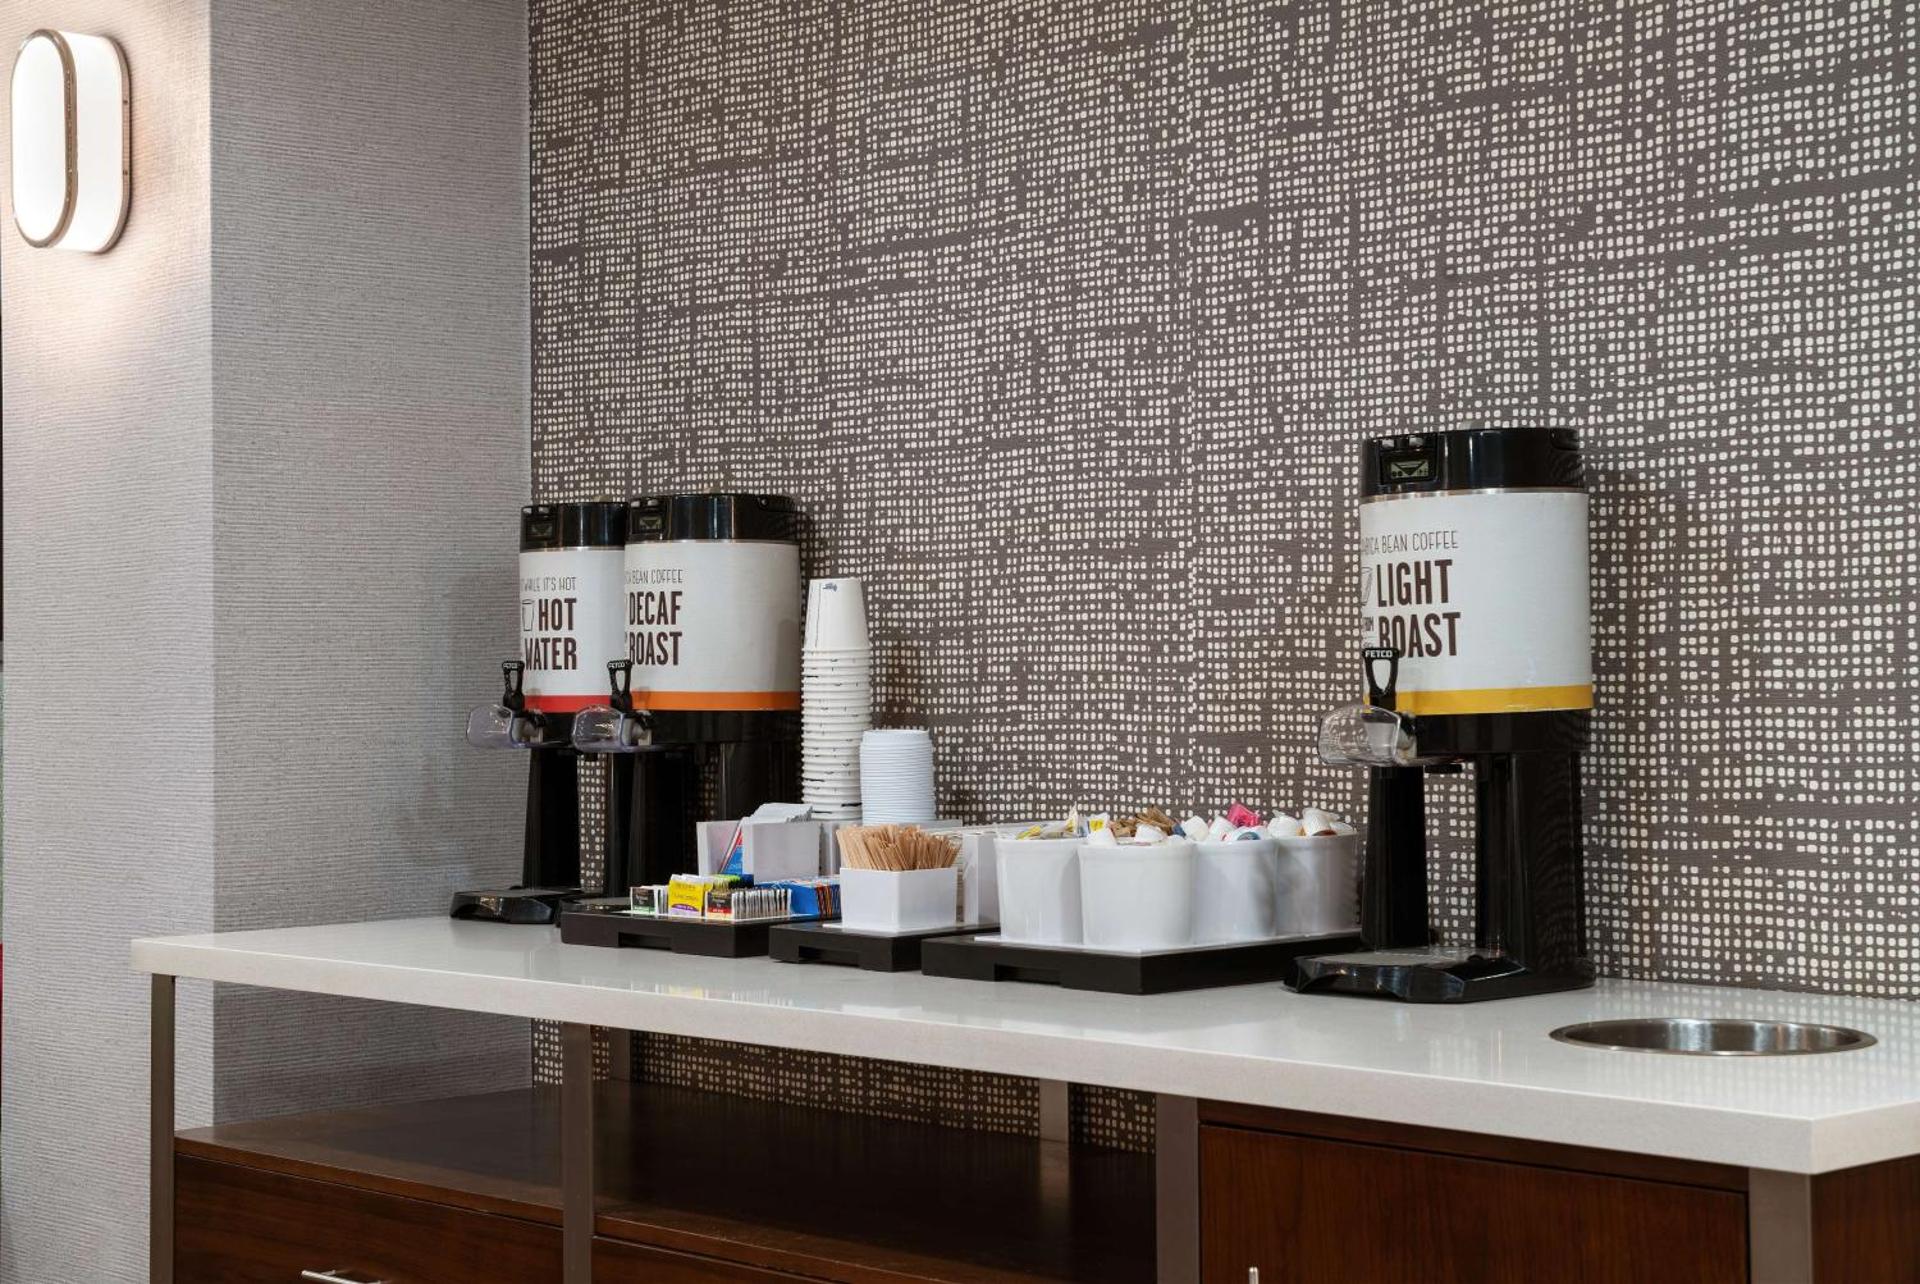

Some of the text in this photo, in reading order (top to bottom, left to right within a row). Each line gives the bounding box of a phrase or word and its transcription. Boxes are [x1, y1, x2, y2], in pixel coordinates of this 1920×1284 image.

[1381, 534, 1407, 554] BEAN
[1412, 530, 1459, 552] COFFEE
[558, 576, 577, 591] HOT
[651, 569, 684, 585] COFFEE
[1376, 559, 1453, 608] LIGHT
[538, 597, 577, 632] HOT
[629, 590, 683, 626] DECAF
[629, 631, 683, 666] ROAST
[1378, 611, 1461, 659] ROAST
[524, 637, 577, 671] WATER
[1365, 650, 1393, 658] FETCO
